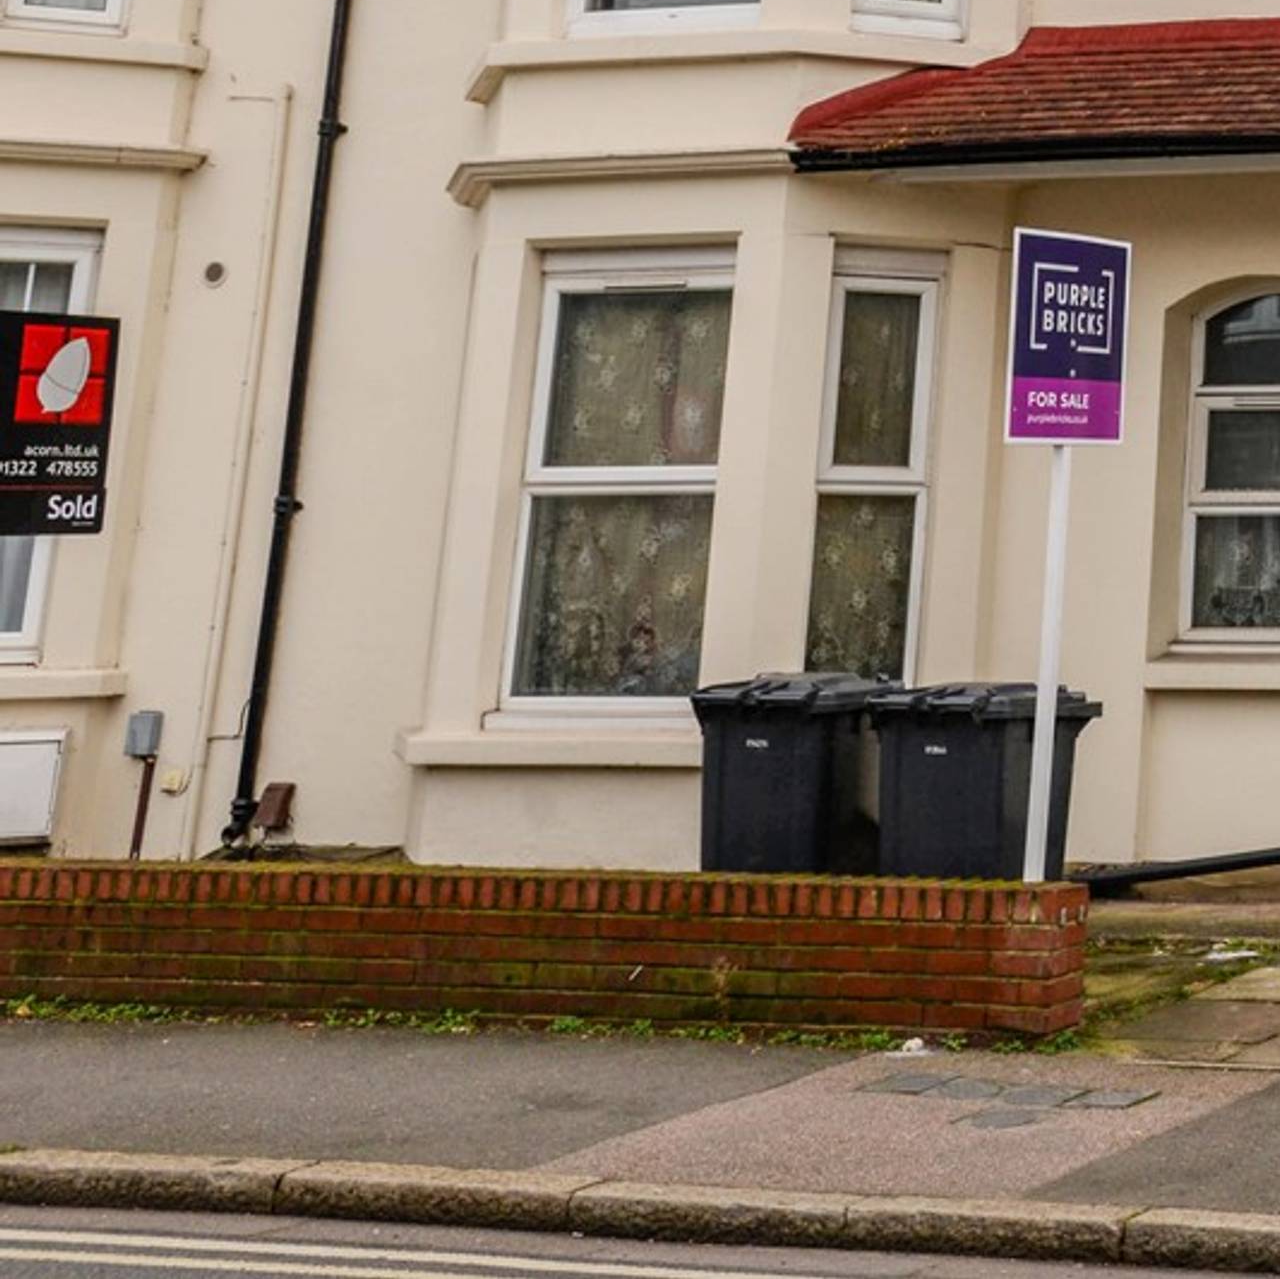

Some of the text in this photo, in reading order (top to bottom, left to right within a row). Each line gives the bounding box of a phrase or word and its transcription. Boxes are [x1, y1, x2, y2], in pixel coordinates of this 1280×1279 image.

[1044, 282, 1106, 310] PURPLE
[1043, 309, 1104, 336] BRICKS
[1027, 391, 1089, 410] FOR SALE
[24, 444, 99, 458] acorn.ltd.uk
[46, 460, 98, 477] 478555
[47, 494, 98, 520] Sold
